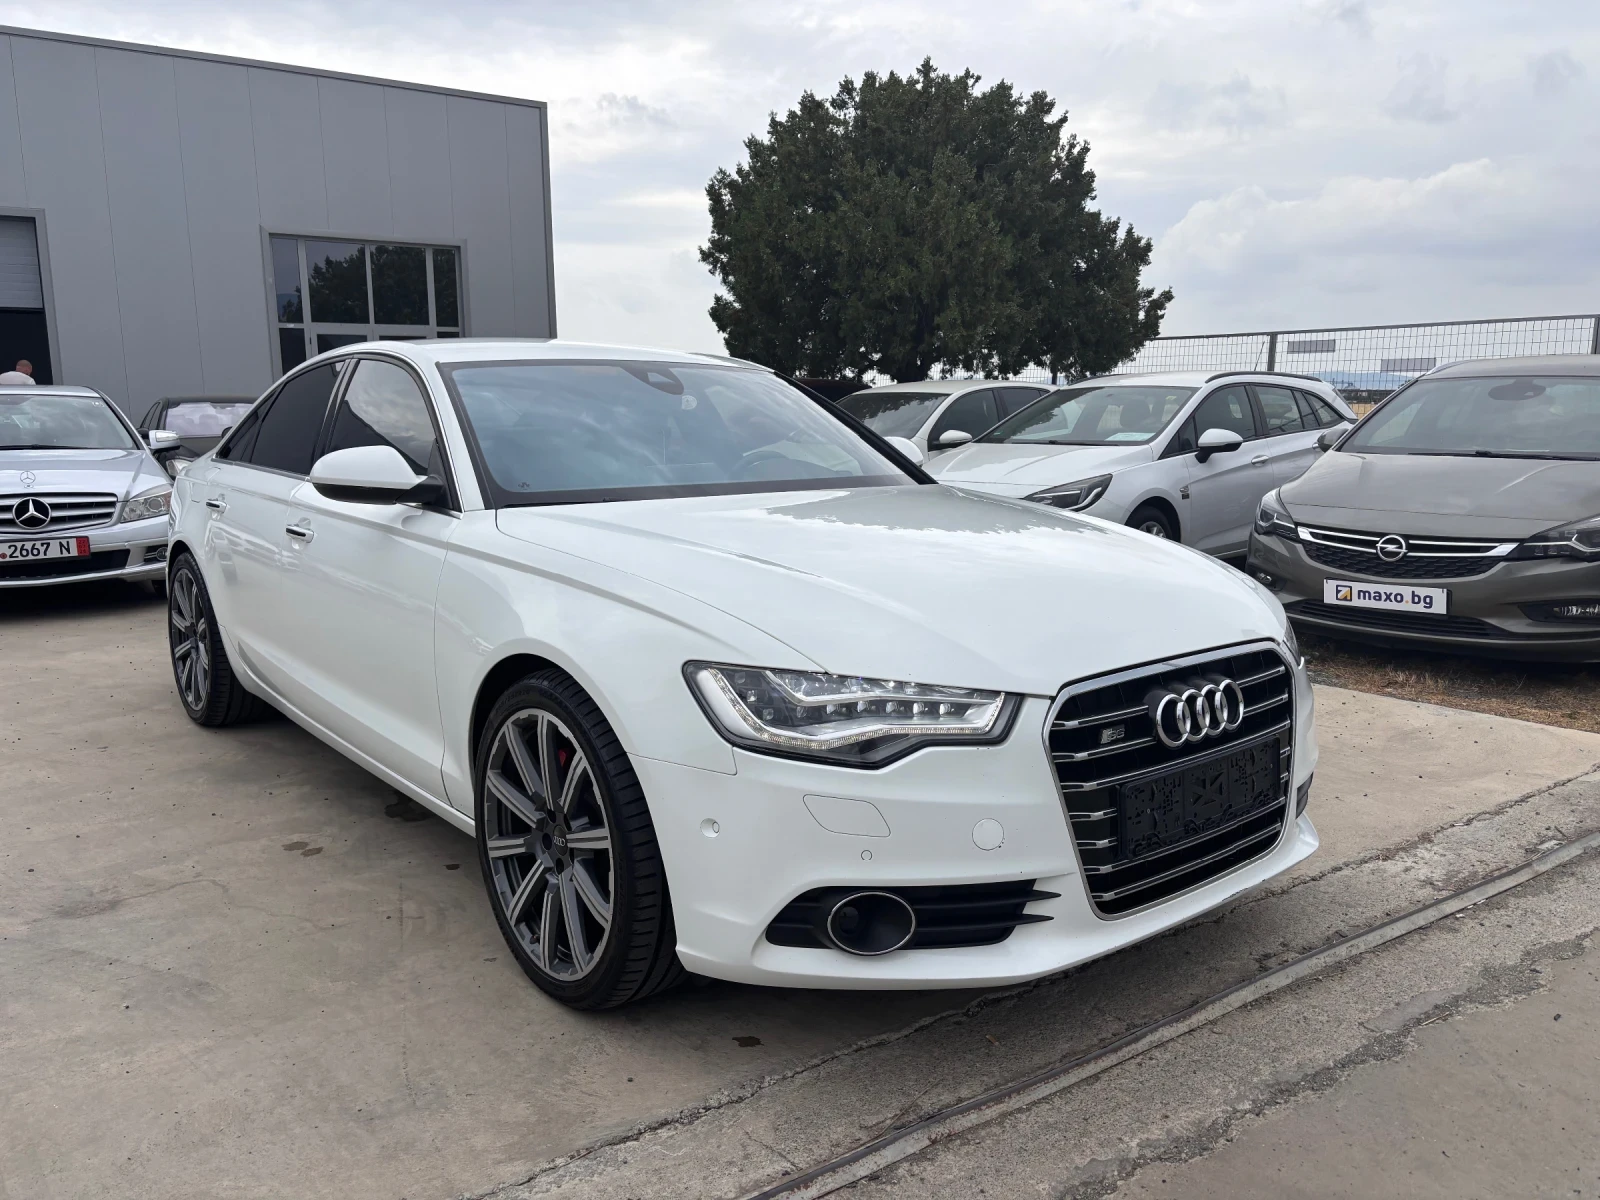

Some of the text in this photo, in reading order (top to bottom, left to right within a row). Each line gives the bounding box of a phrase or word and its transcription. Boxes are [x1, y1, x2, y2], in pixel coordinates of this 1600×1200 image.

[7, 540, 71, 559] 2667 N
[1357, 589, 1434, 609] maxo.bg
